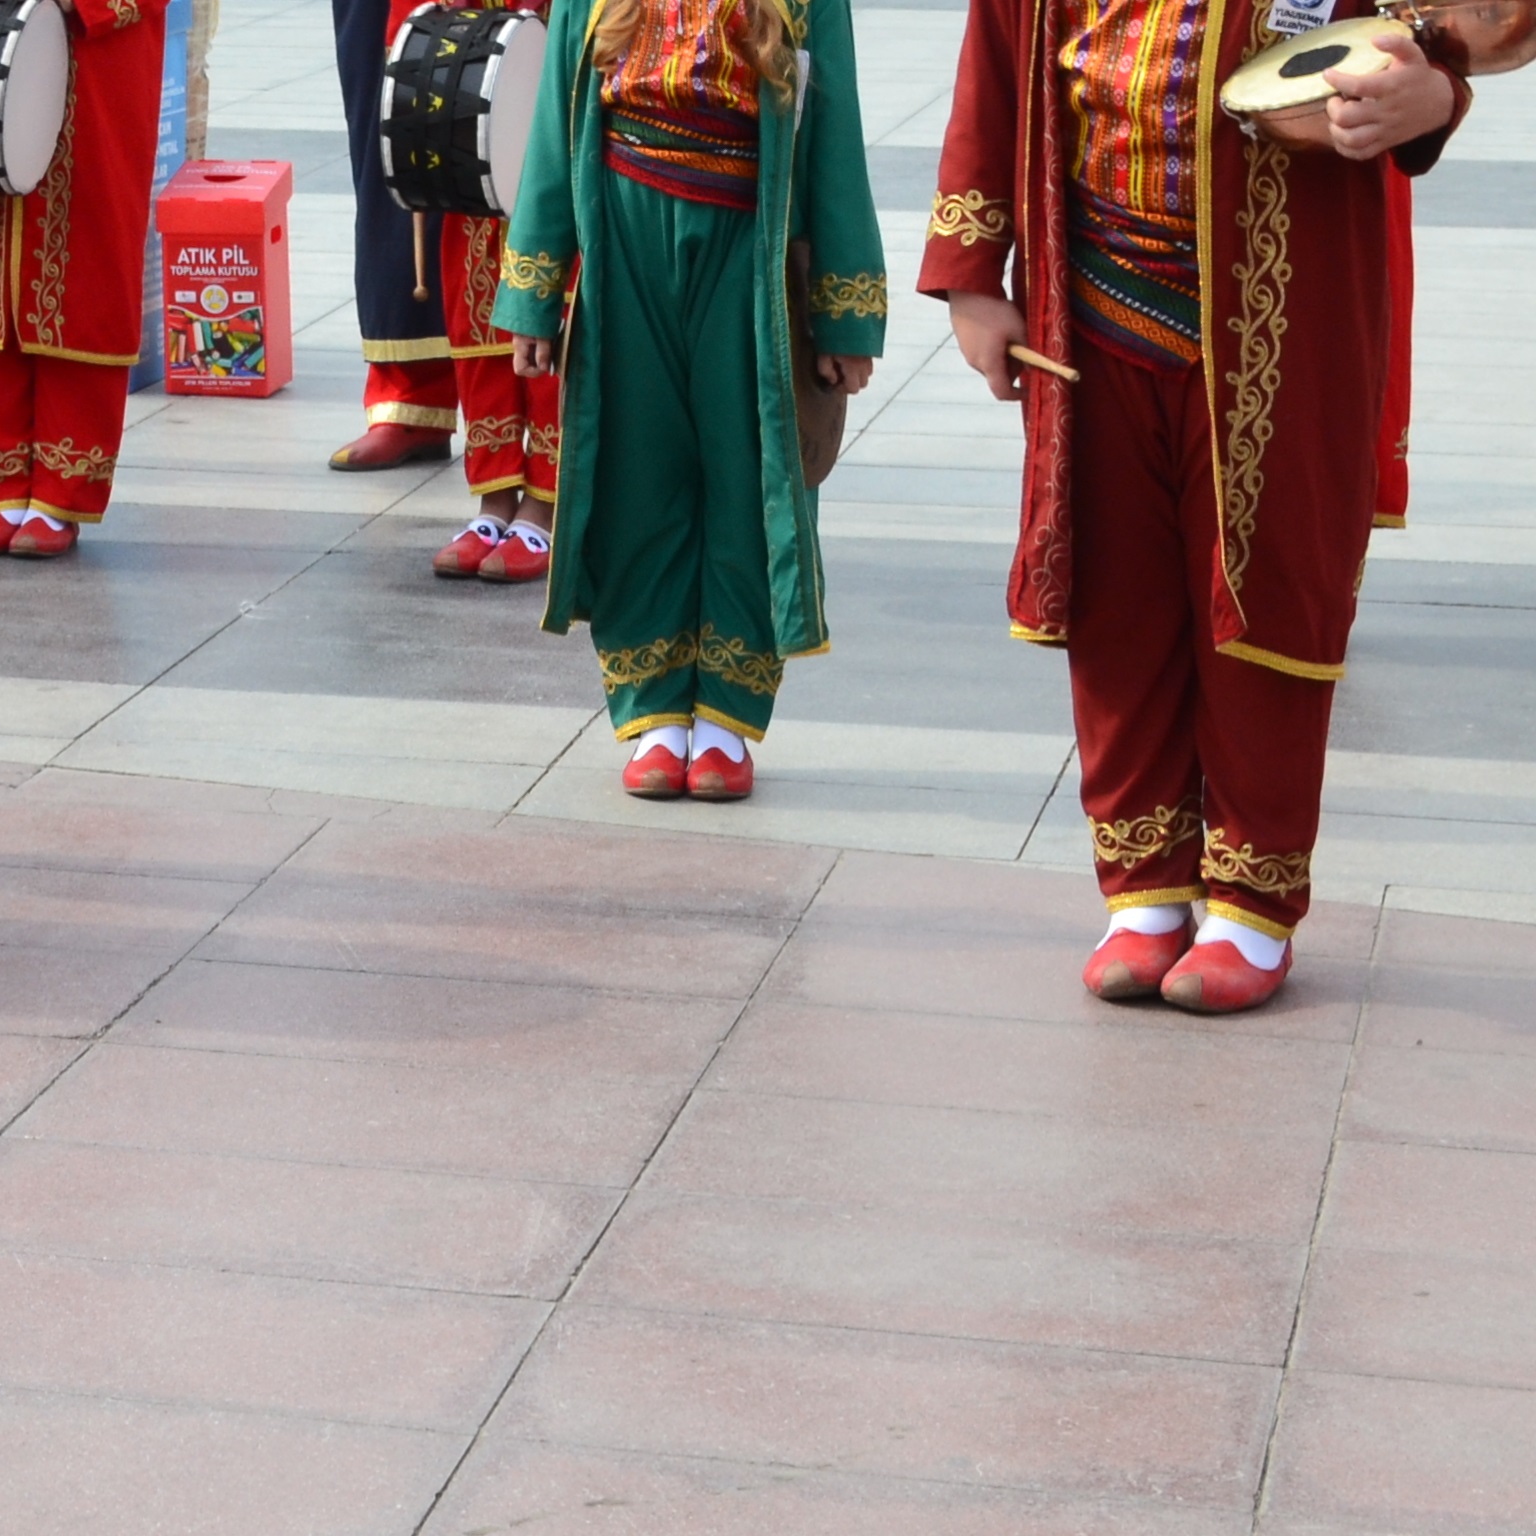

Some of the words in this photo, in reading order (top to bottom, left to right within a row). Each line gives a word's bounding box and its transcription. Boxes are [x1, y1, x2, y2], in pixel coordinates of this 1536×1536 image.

[177, 247, 217, 264] ATIK
[222, 244, 250, 265] PİL
[170, 265, 217, 276] TOPLAMA
[218, 265, 259, 277] KUTUSU
